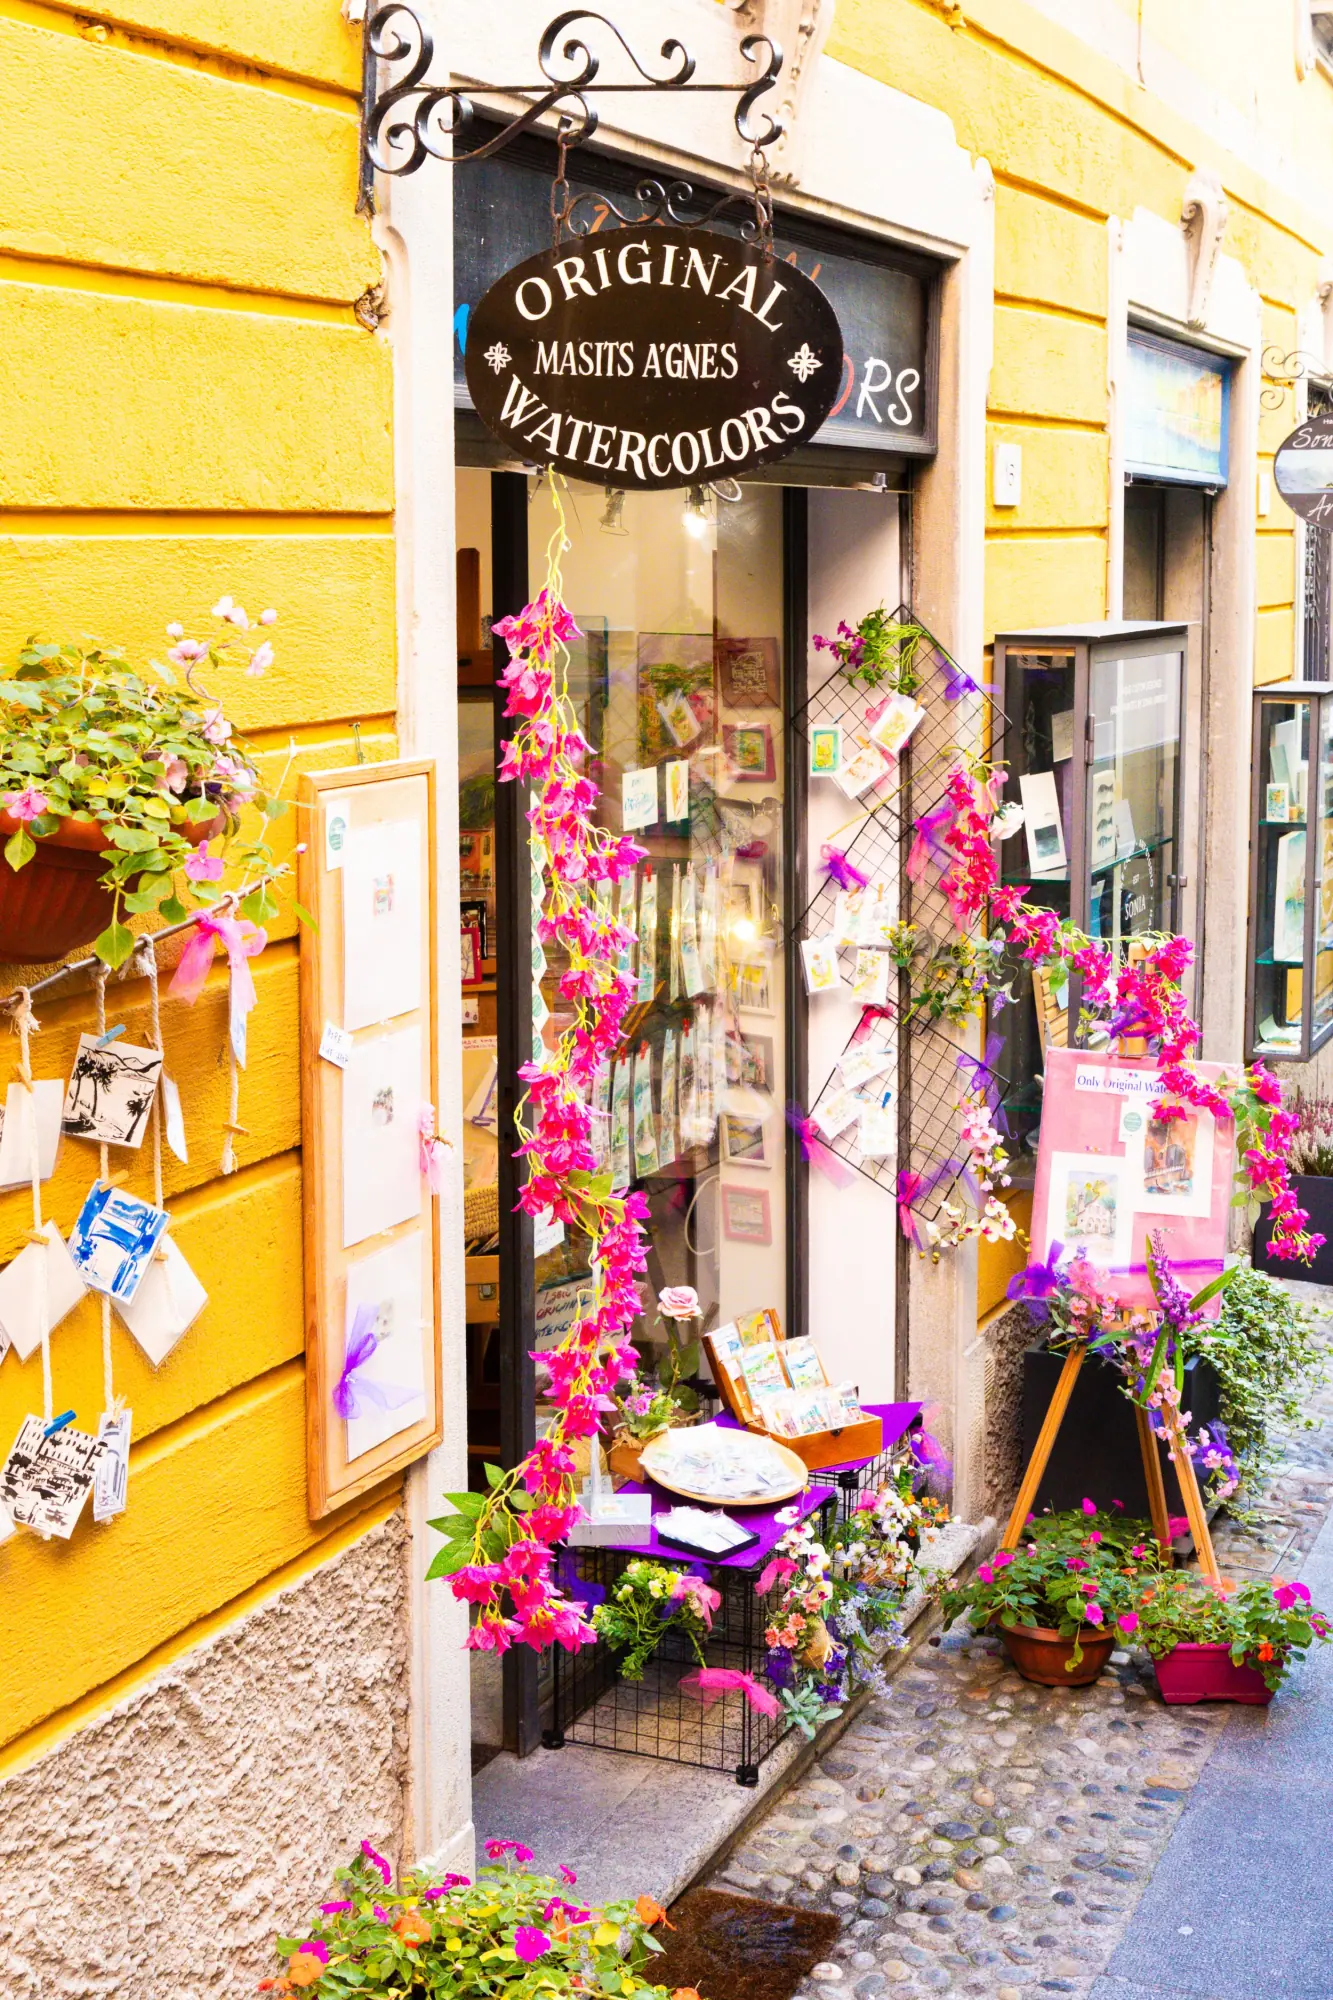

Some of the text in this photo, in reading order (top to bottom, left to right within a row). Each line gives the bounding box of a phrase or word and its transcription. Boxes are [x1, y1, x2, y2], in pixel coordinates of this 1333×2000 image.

[516, 240, 787, 332] ORIGINAL
[534, 341, 634, 376] MASITS
[500, 373, 806, 480] WATERCOLORS
[1124, 895, 1146, 921] SONIA
[1077, 1075, 1100, 1087] Only
[1104, 1078, 1142, 1093] Original
